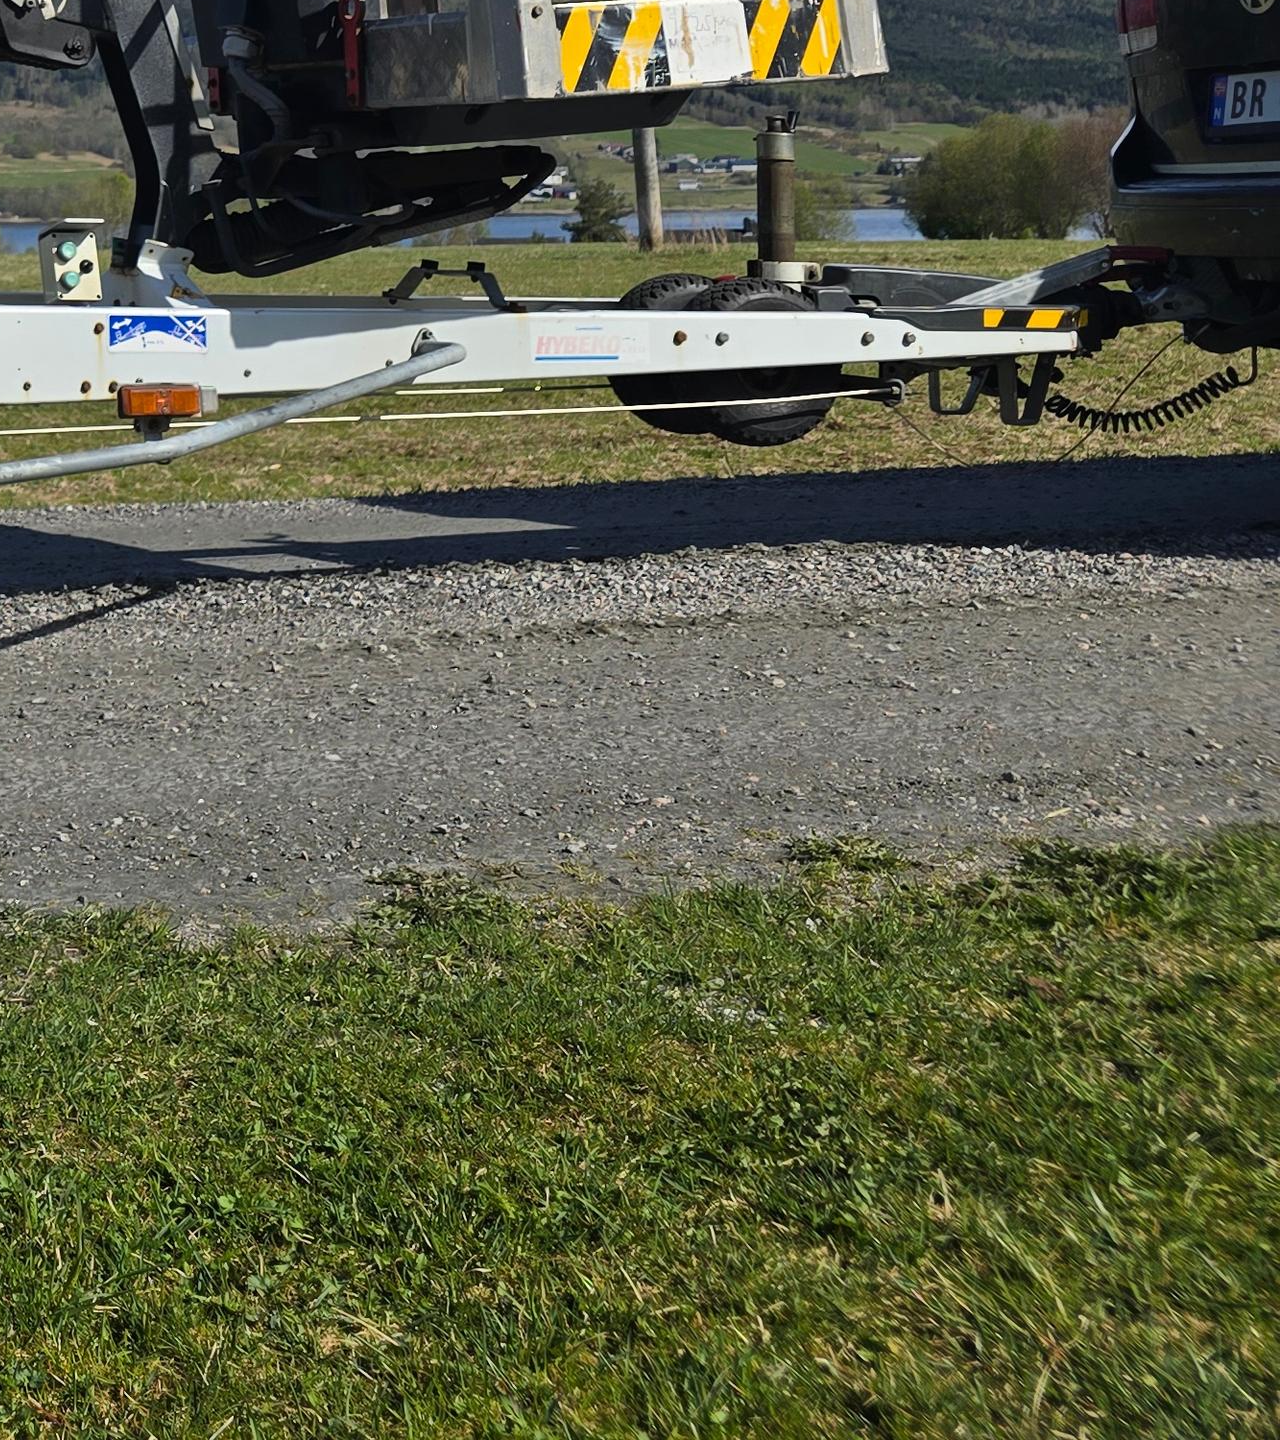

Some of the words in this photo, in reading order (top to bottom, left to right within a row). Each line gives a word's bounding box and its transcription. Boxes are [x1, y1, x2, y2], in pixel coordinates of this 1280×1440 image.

[1213, 106, 1222, 121] N
[1231, 78, 1267, 120] BR
[535, 335, 620, 354] HYBEKO
